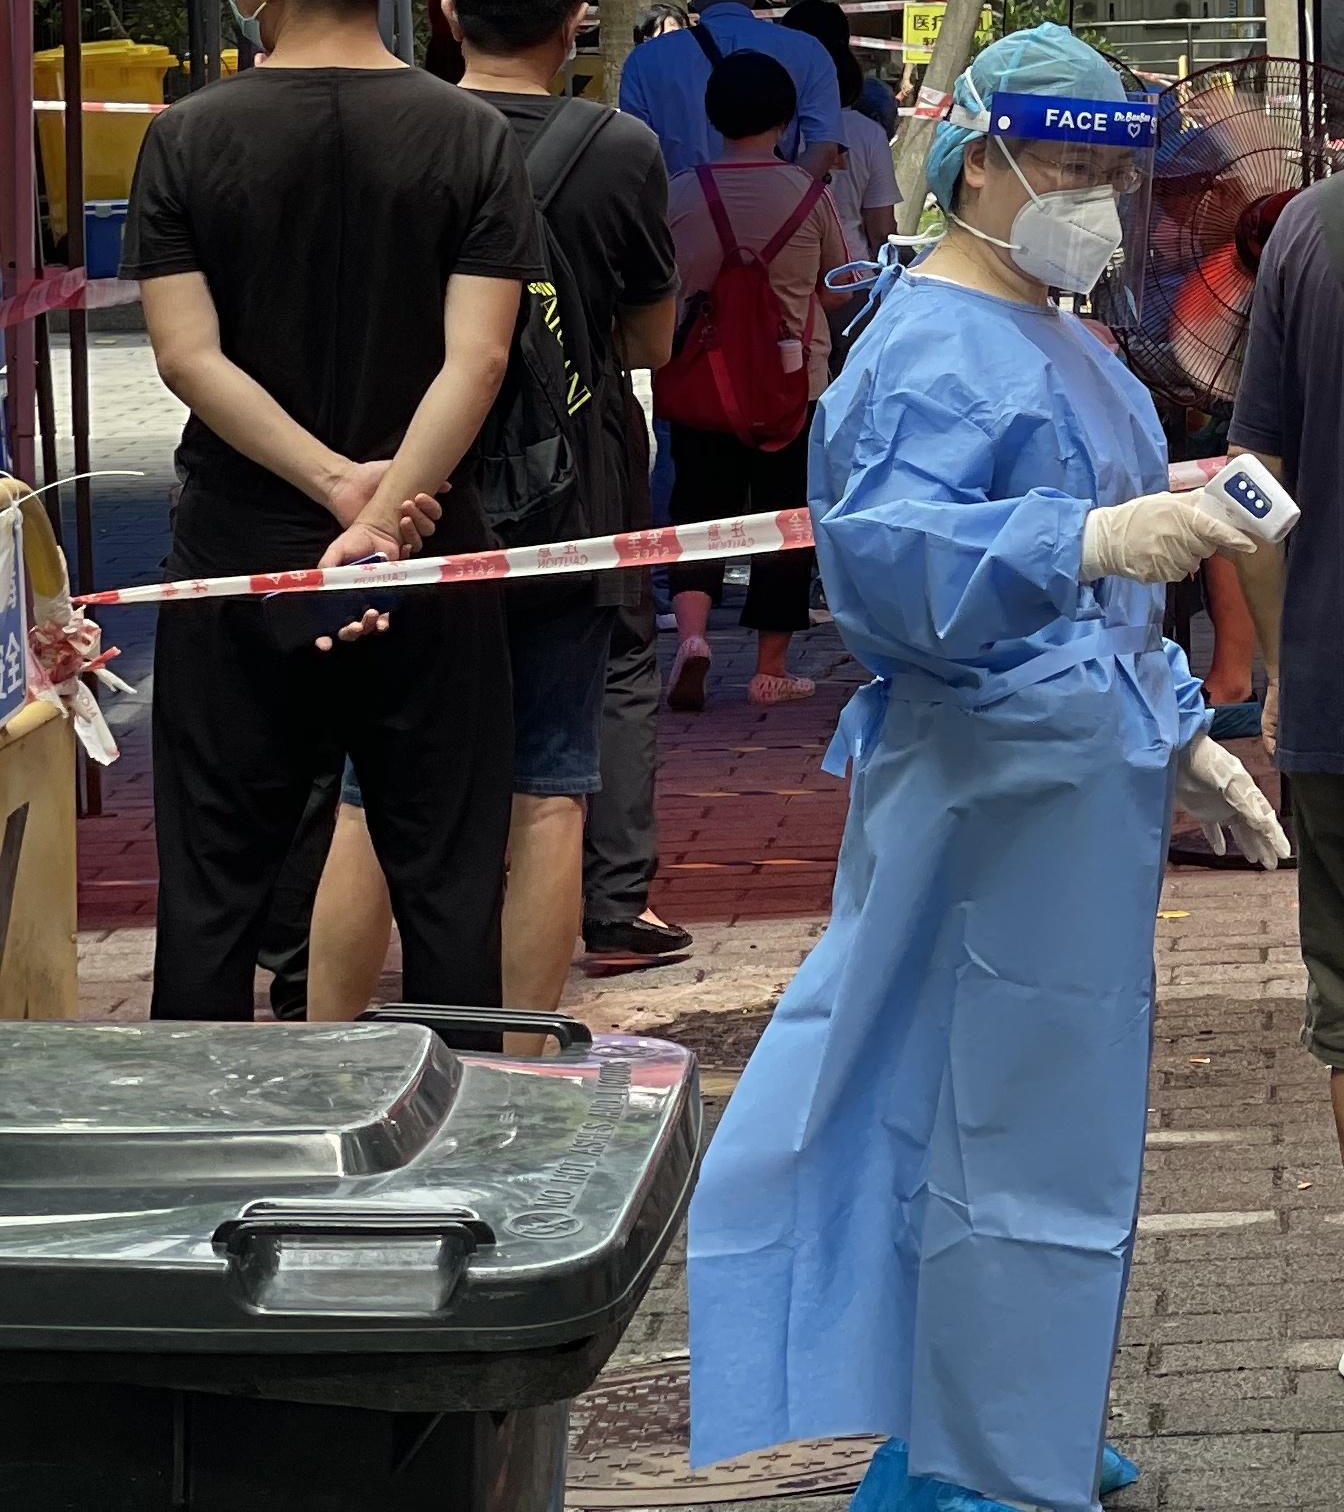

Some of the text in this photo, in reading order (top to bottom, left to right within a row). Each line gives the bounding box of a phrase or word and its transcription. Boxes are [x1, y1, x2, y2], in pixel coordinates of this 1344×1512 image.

[1045, 108, 1108, 132] FACE
[568, 1121, 616, 1157] ASHES
[549, 1159, 597, 1186] HOT
[533, 1188, 576, 1210] NO
